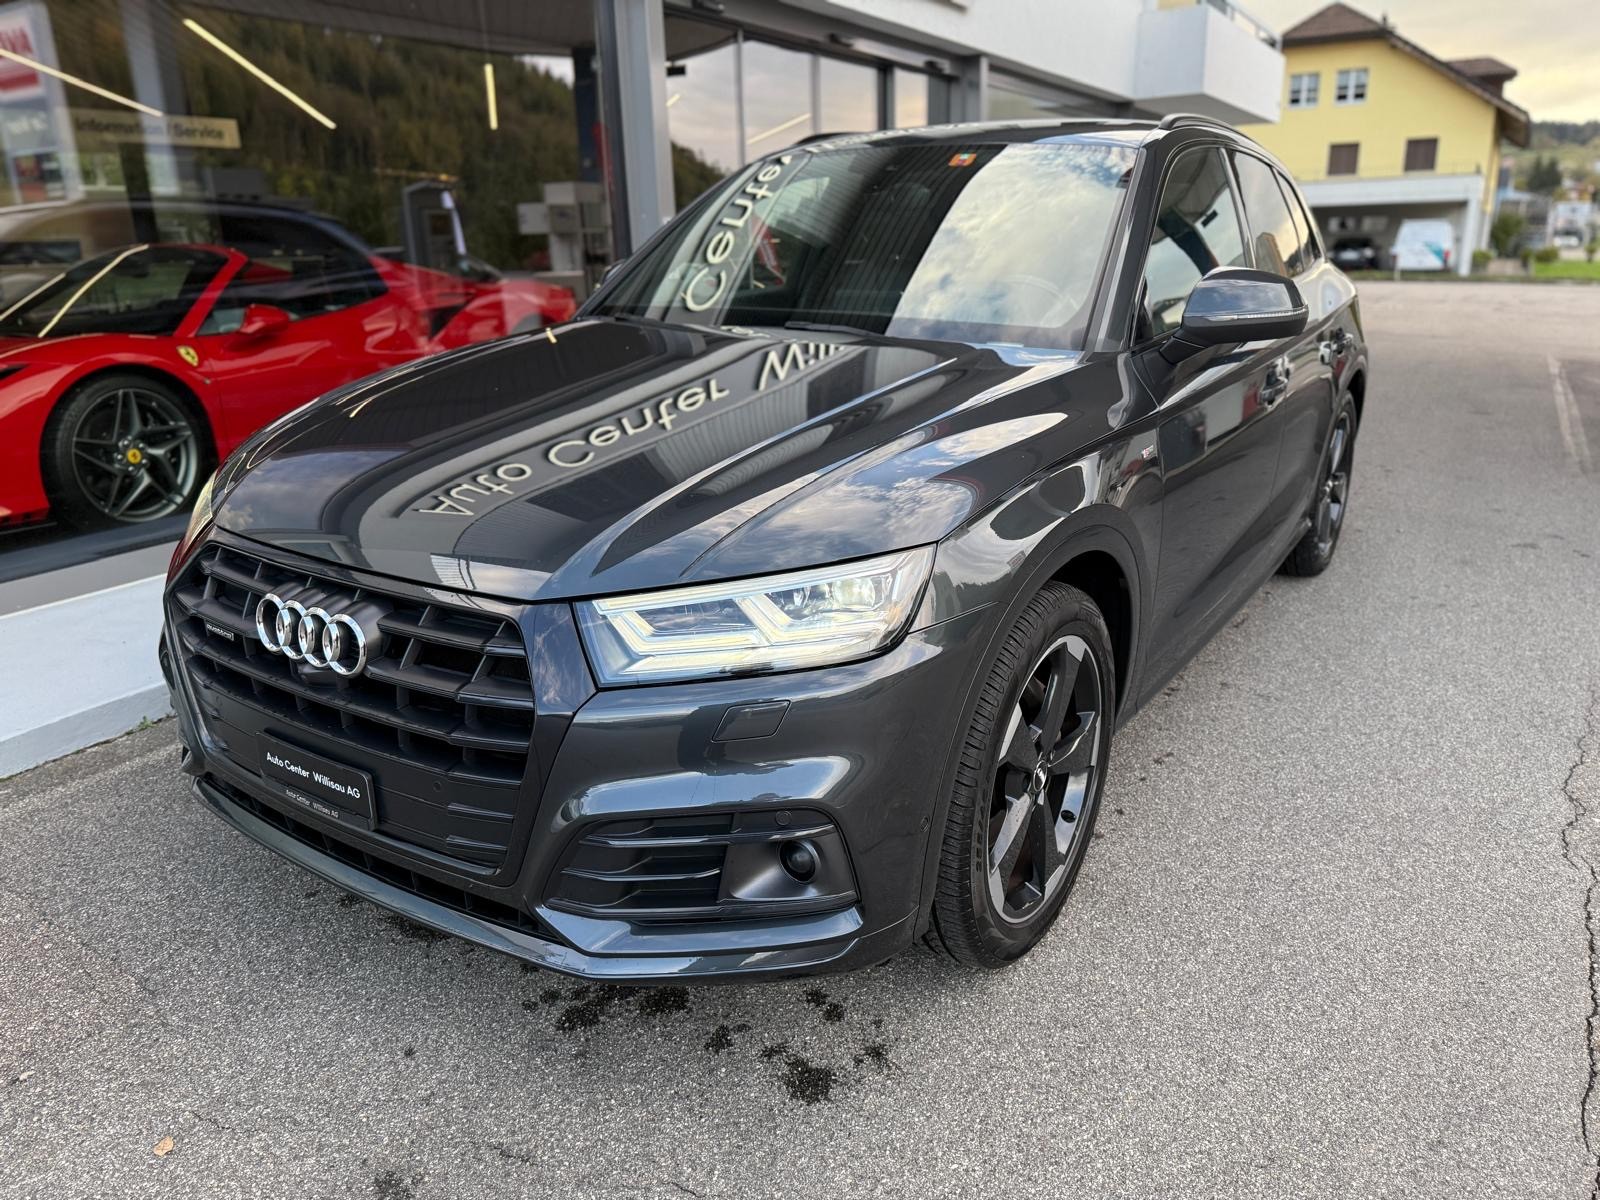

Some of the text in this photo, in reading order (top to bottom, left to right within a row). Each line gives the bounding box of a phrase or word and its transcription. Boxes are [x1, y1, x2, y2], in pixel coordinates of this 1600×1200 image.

[173, 122, 225, 140] Service
[267, 752, 360, 799] Auto Center Willisau AG
